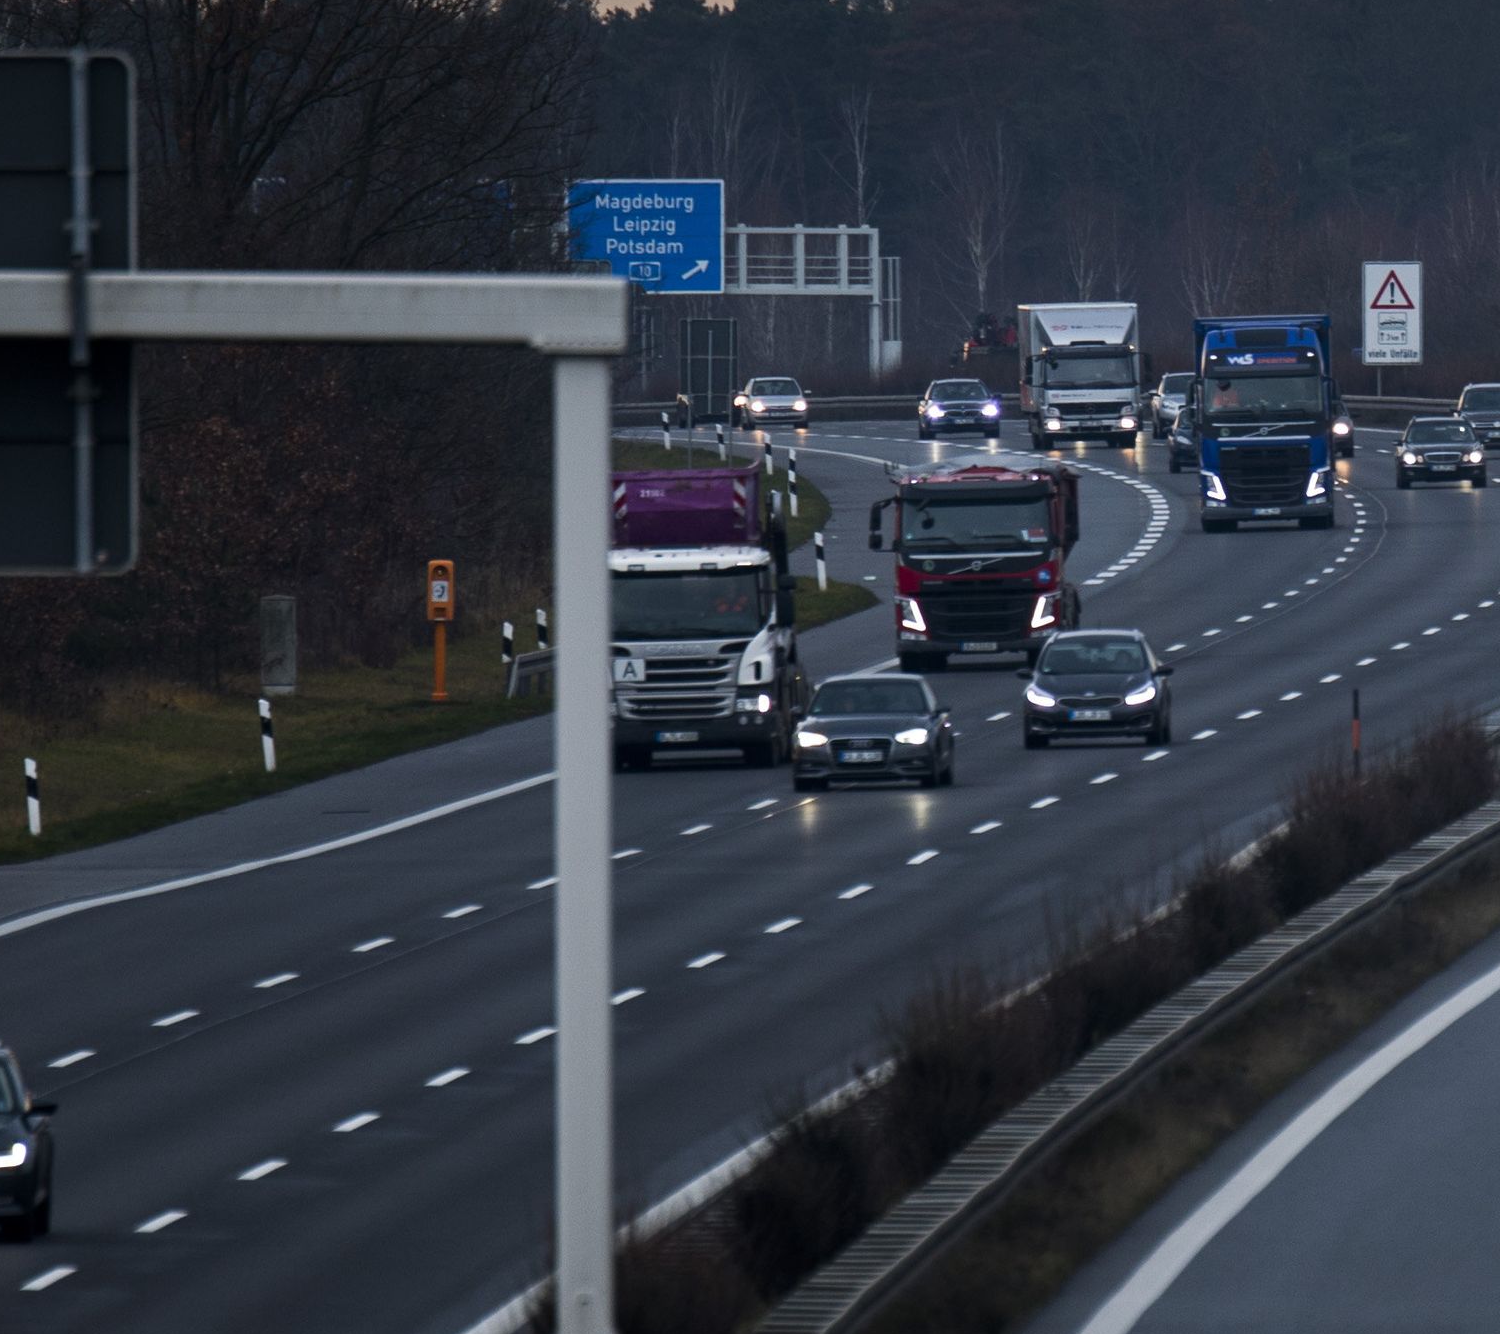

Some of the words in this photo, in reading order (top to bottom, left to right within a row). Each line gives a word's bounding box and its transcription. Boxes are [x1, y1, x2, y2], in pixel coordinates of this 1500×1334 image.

[595, 193, 694, 213] Magdeburg
[613, 216, 676, 236] Leipzig
[606, 238, 684, 255] Potsdam
[639, 264, 652, 279] 10
[1368, 350, 1386, 358] viele
[1390, 349, 1418, 358] Unfälle
[622, 661, 638, 679] A
